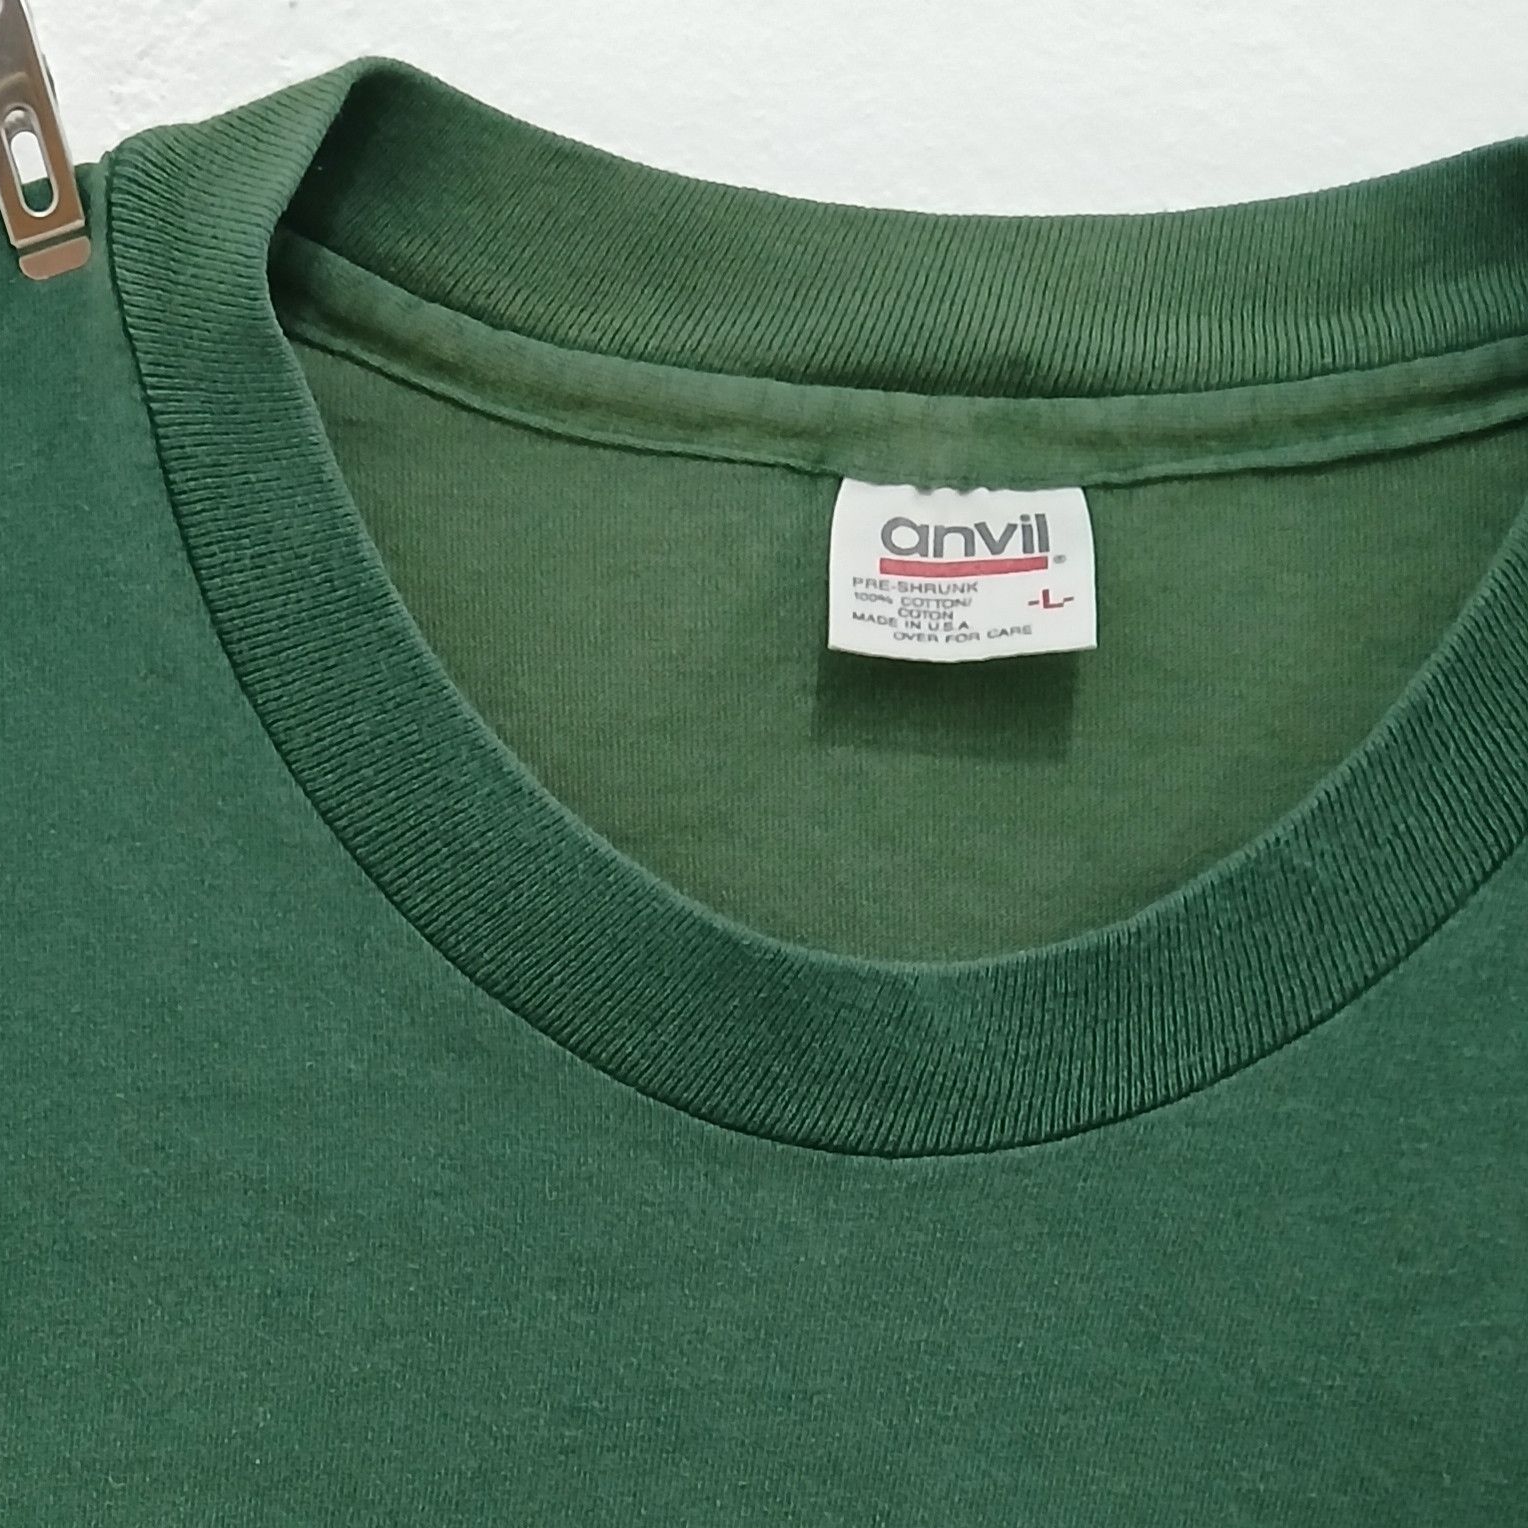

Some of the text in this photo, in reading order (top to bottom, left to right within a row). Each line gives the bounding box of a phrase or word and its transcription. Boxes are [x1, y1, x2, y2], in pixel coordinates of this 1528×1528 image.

[881, 513, 1050, 558] anvil
[852, 577, 978, 594] PRE-SHRUNK
[854, 592, 893, 604] 100%
[852, 612, 897, 627] MADE
[904, 620, 922, 630] IN
[897, 607, 954, 620] COTON
[893, 625, 1033, 643] OVER FOR CARE
